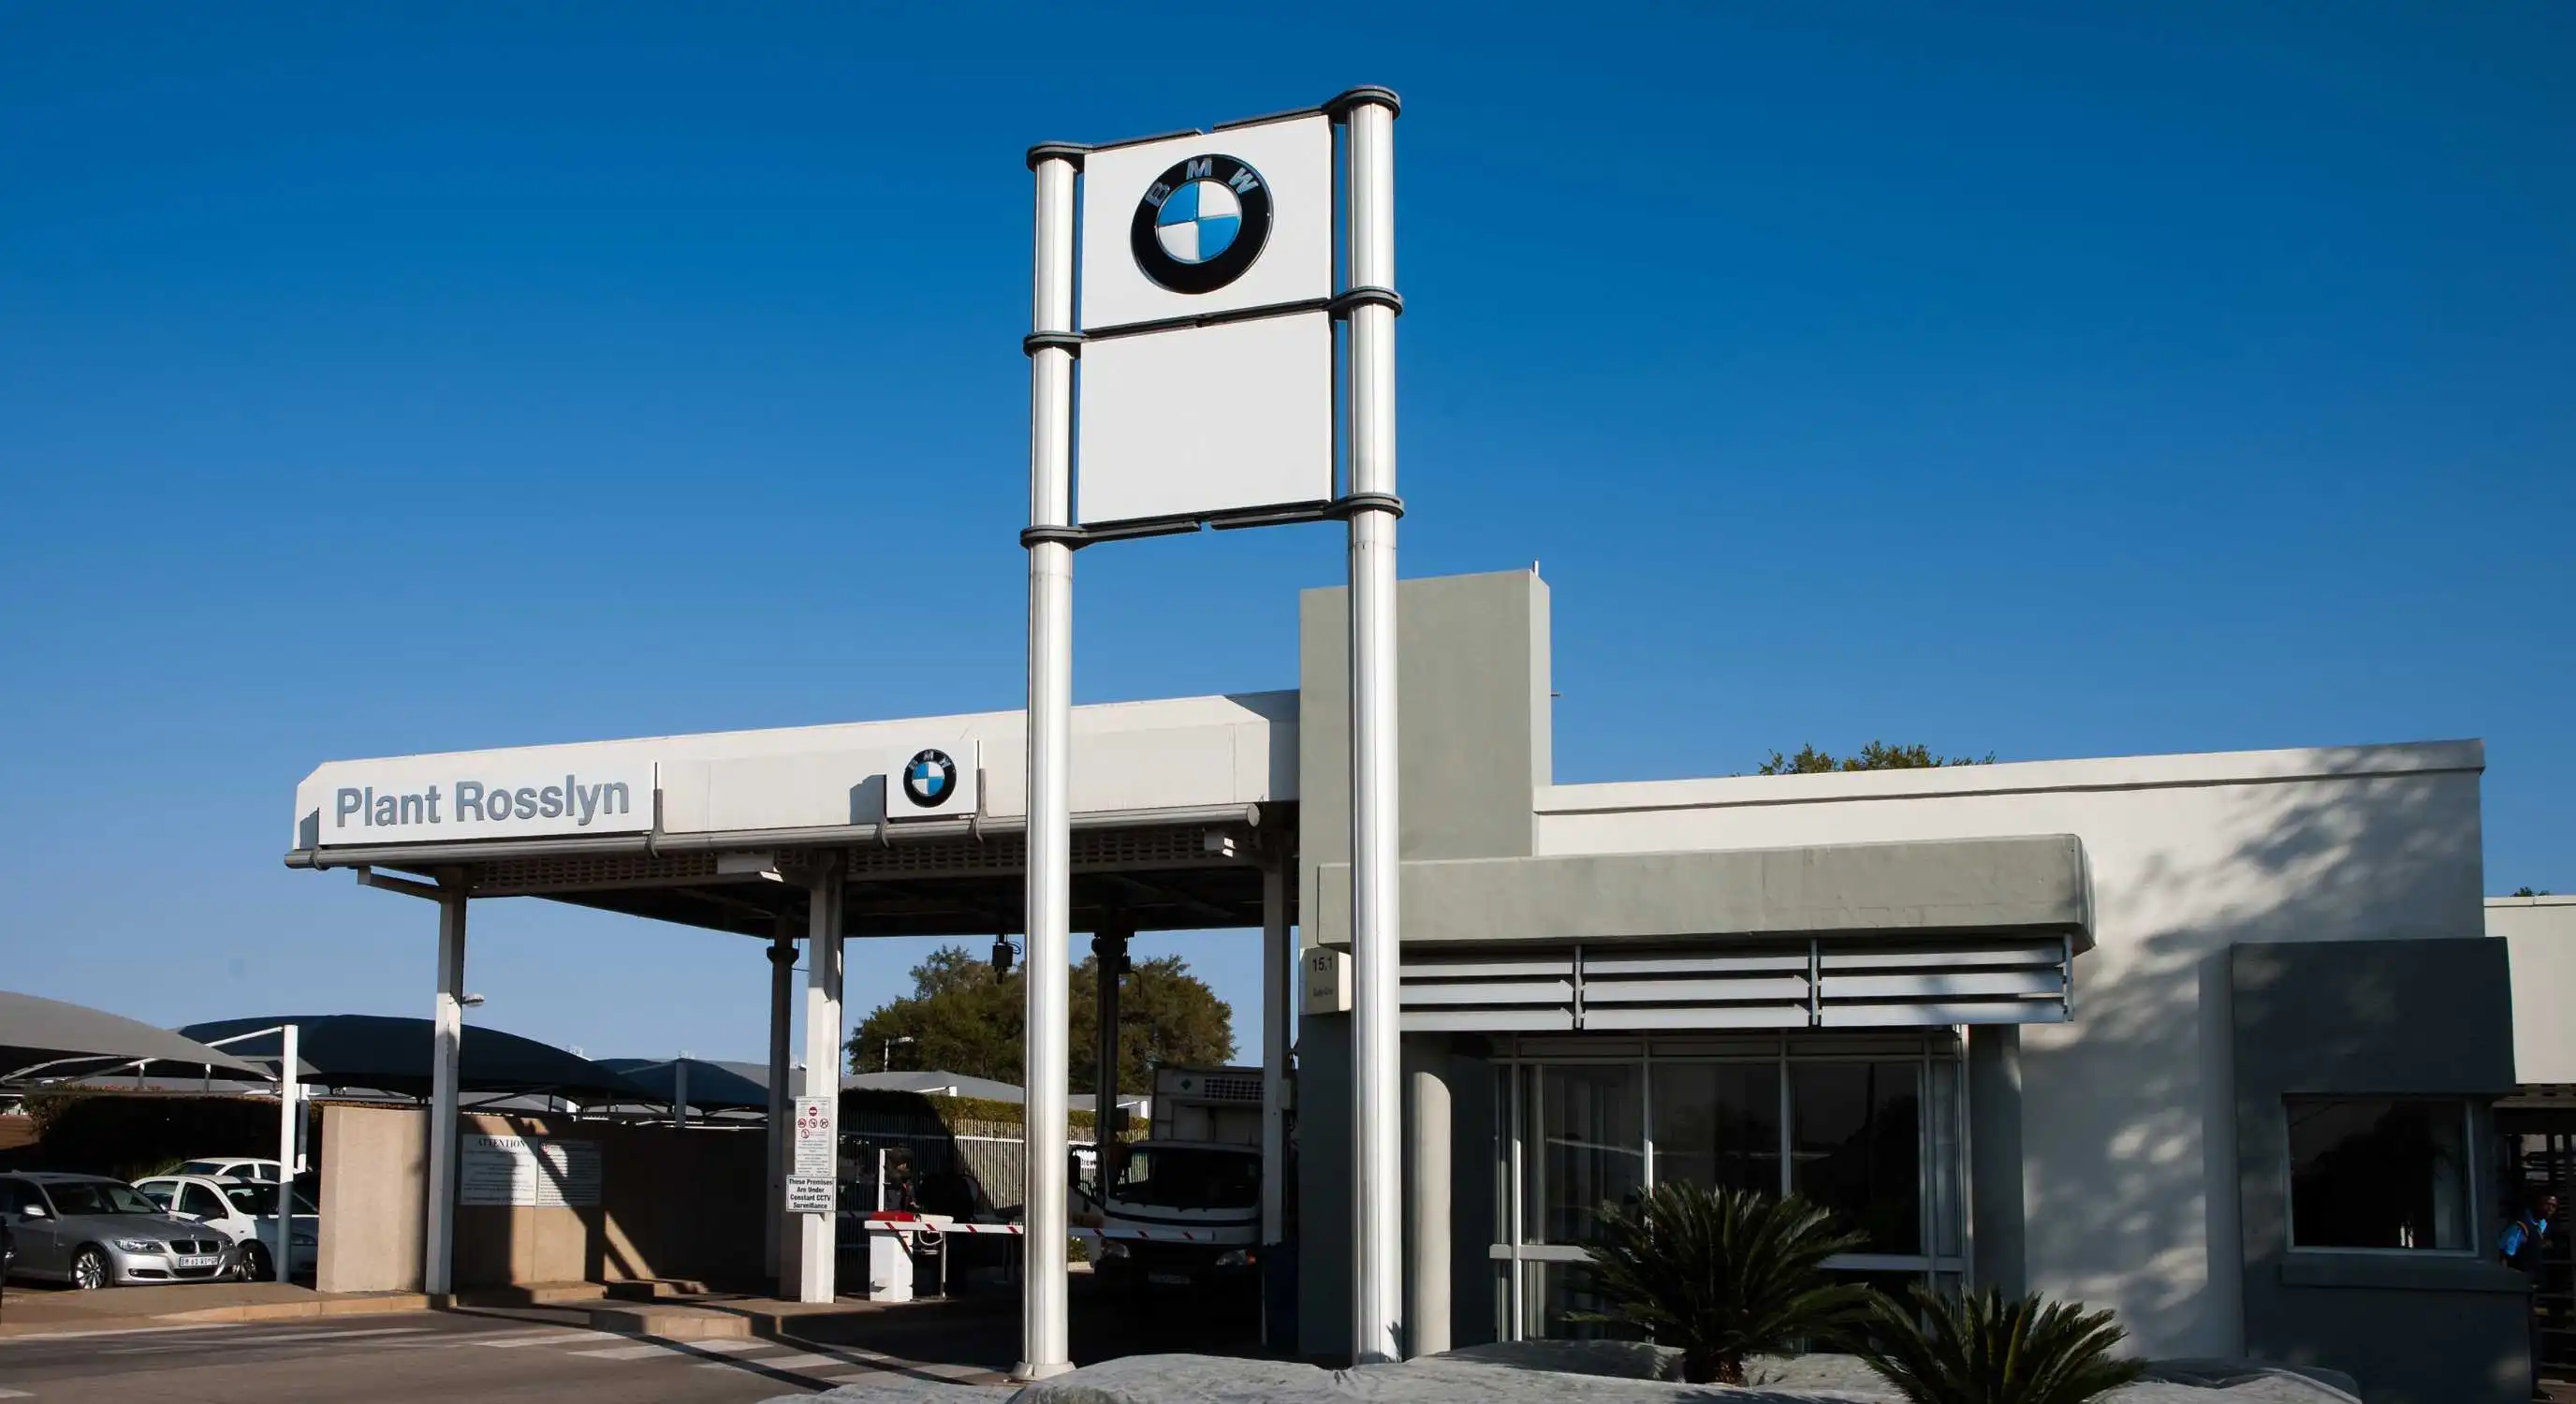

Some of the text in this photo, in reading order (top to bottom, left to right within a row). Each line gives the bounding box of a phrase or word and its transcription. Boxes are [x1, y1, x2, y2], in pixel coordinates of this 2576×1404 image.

[1145, 157, 1259, 208] BMW
[908, 751, 952, 770] BMW
[336, 774, 630, 828] Plant Rosslyn
[477, 1137, 526, 1148] ATTENTION
